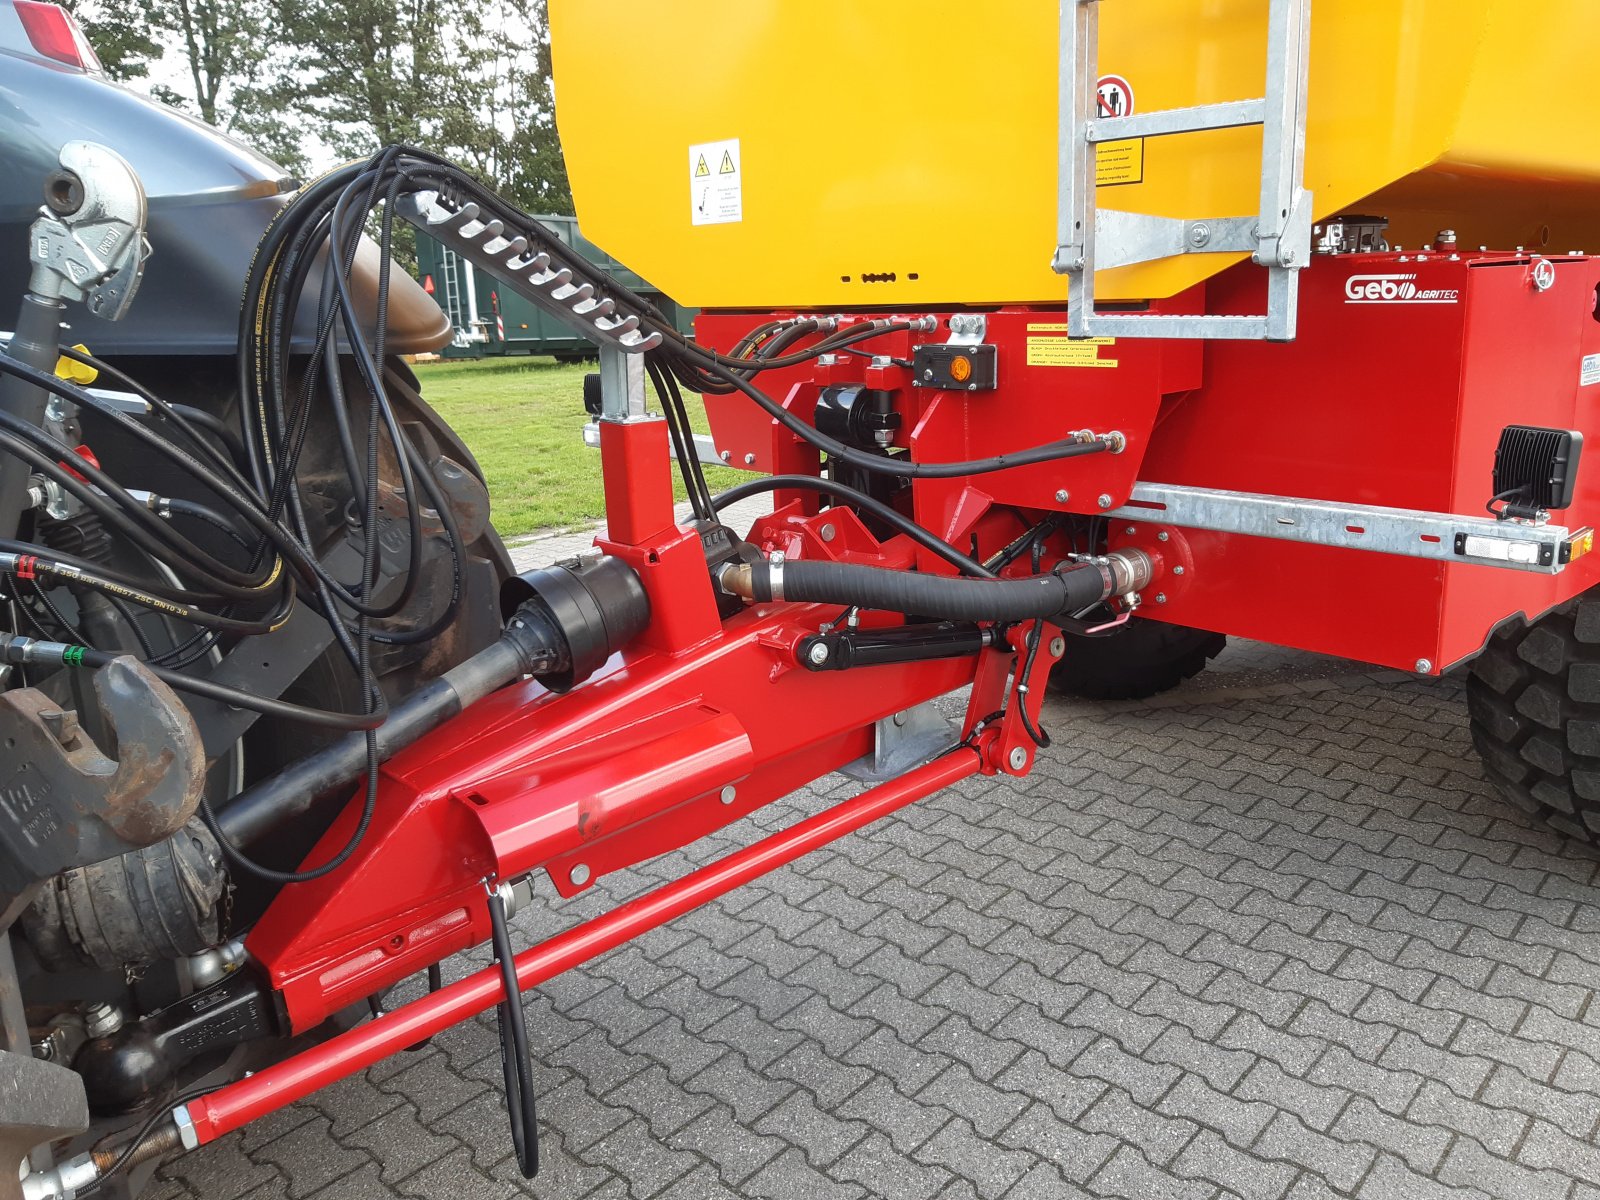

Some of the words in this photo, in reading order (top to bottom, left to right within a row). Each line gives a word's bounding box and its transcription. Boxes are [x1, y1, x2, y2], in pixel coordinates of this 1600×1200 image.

[1345, 274, 1416, 299] Gebo
[1414, 290, 1458, 299] AGRITEC
[60, 570, 79, 579] 350
[104, 582, 134, 597] EN857
[135, 594, 152, 604] 2SC
[153, 600, 175, 612] DN10
